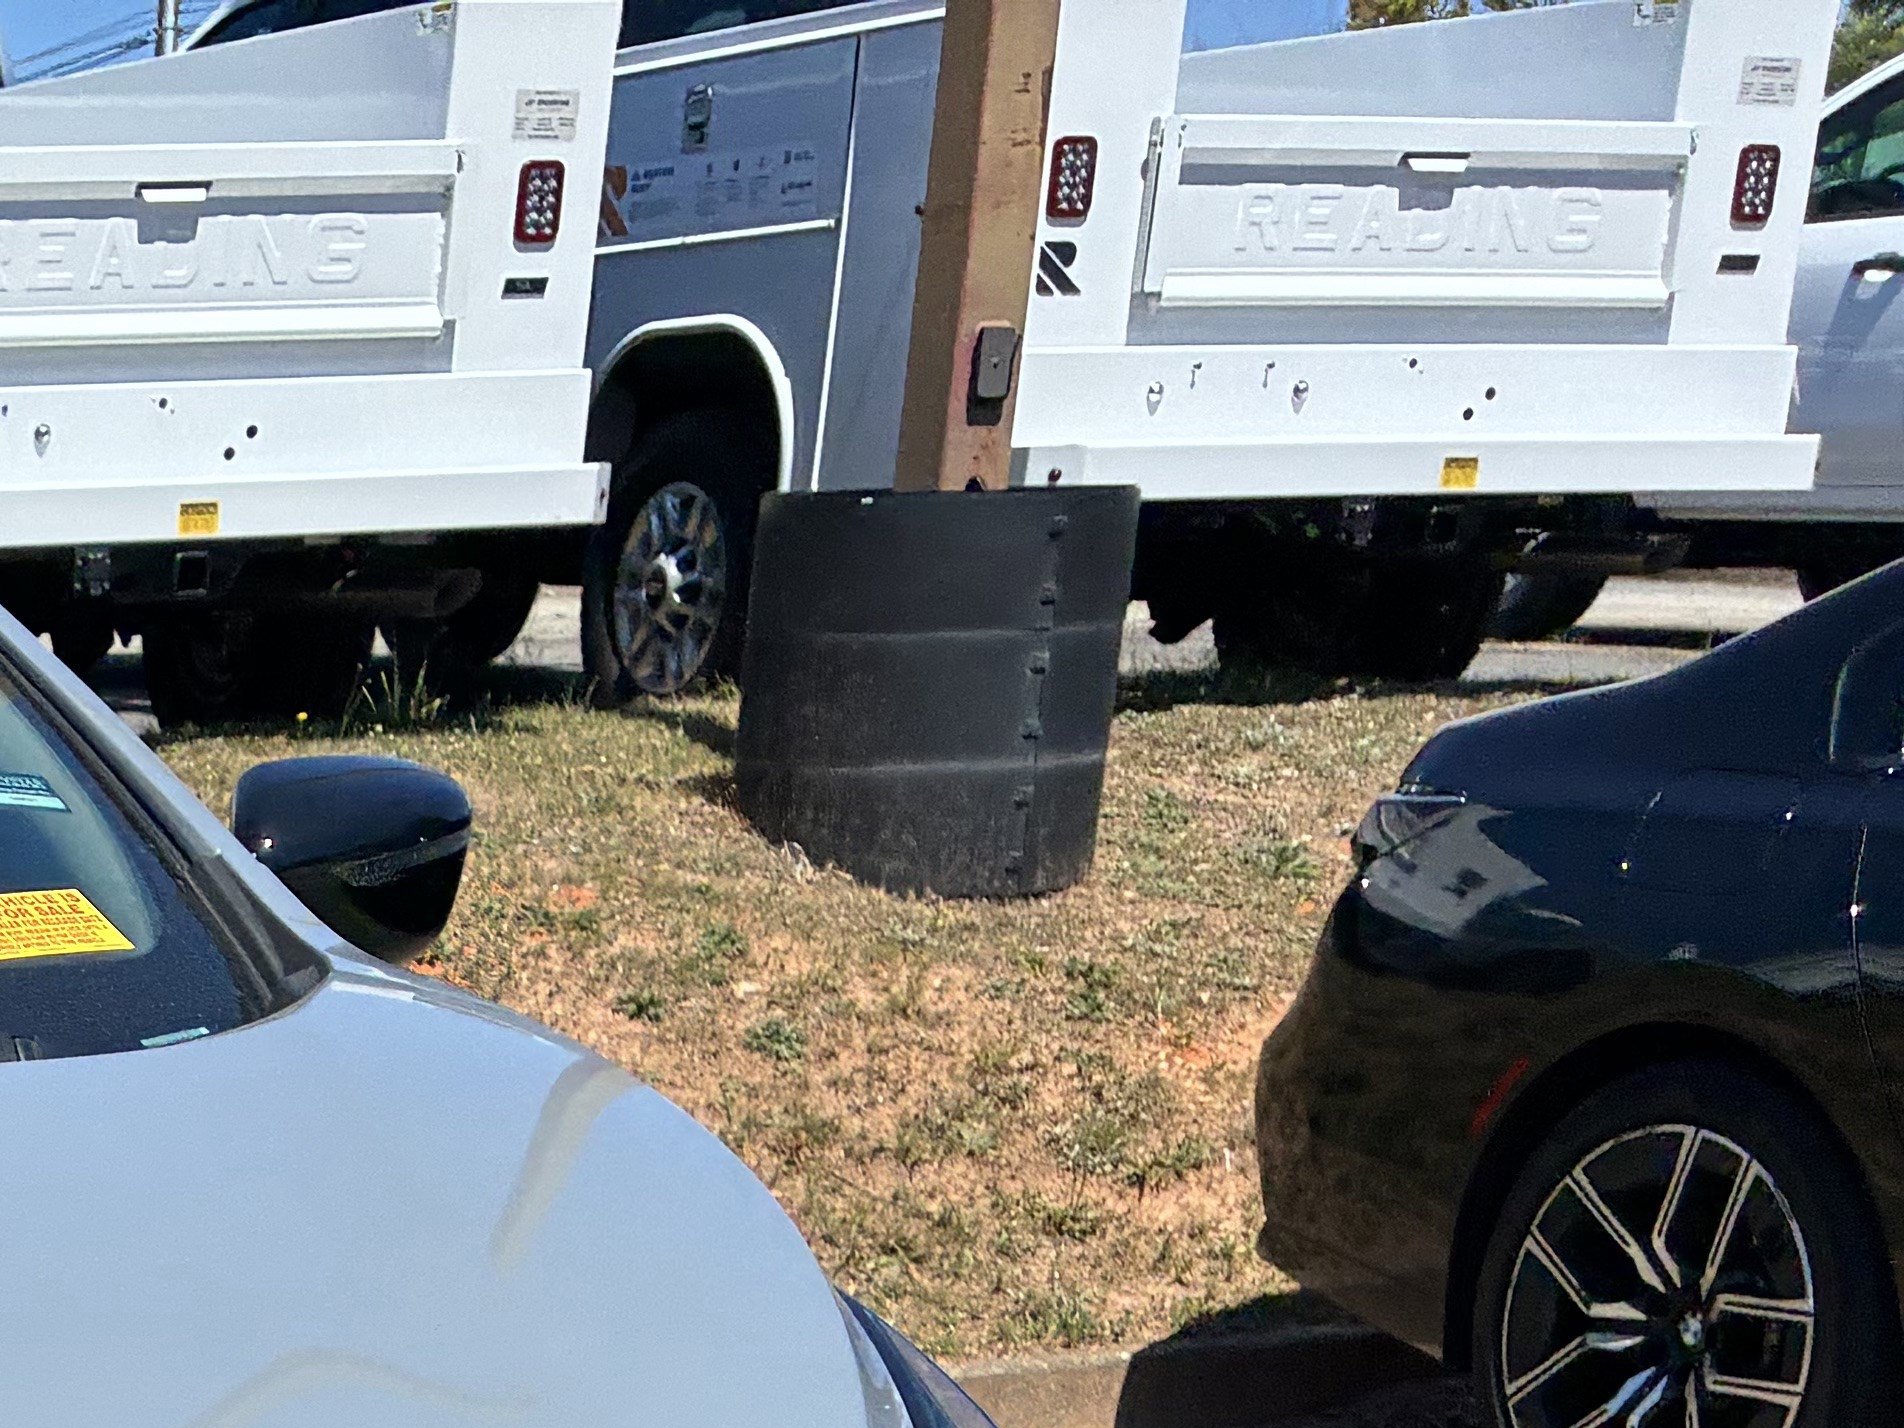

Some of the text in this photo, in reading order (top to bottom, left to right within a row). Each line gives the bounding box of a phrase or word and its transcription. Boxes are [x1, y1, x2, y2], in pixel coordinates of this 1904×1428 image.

[1233, 184, 1602, 253] READING
[58, 892, 81, 903] IS
[34, 903, 85, 916] SALE
